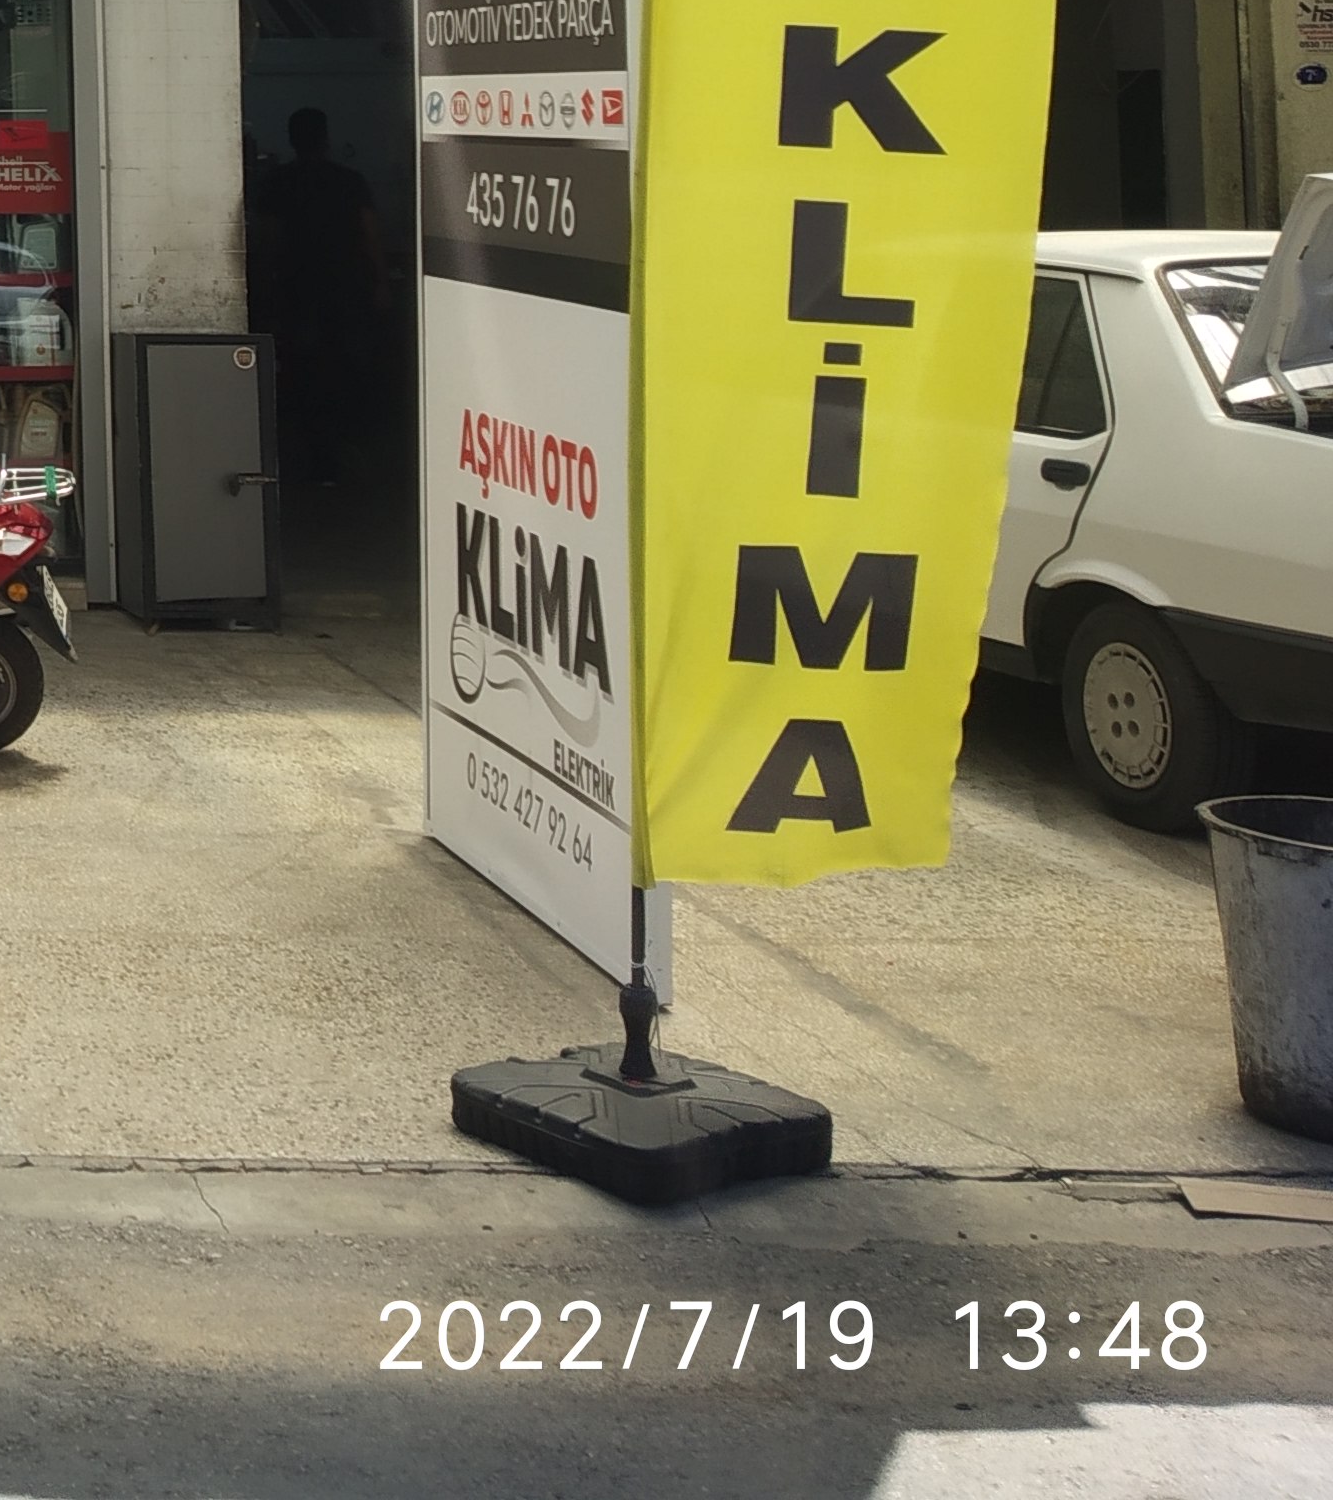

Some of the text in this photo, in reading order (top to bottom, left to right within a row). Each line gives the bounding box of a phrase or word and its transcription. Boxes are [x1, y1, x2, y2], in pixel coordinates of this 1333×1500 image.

[504, 0, 555, 44] YEDEK
[466, 172, 575, 237] 435 76 76
[459, 408, 598, 520] AŞKIN OTO
[467, 752, 593, 872] 0 532 427 92 64
[553, 738, 616, 812] ELEKTRİK
